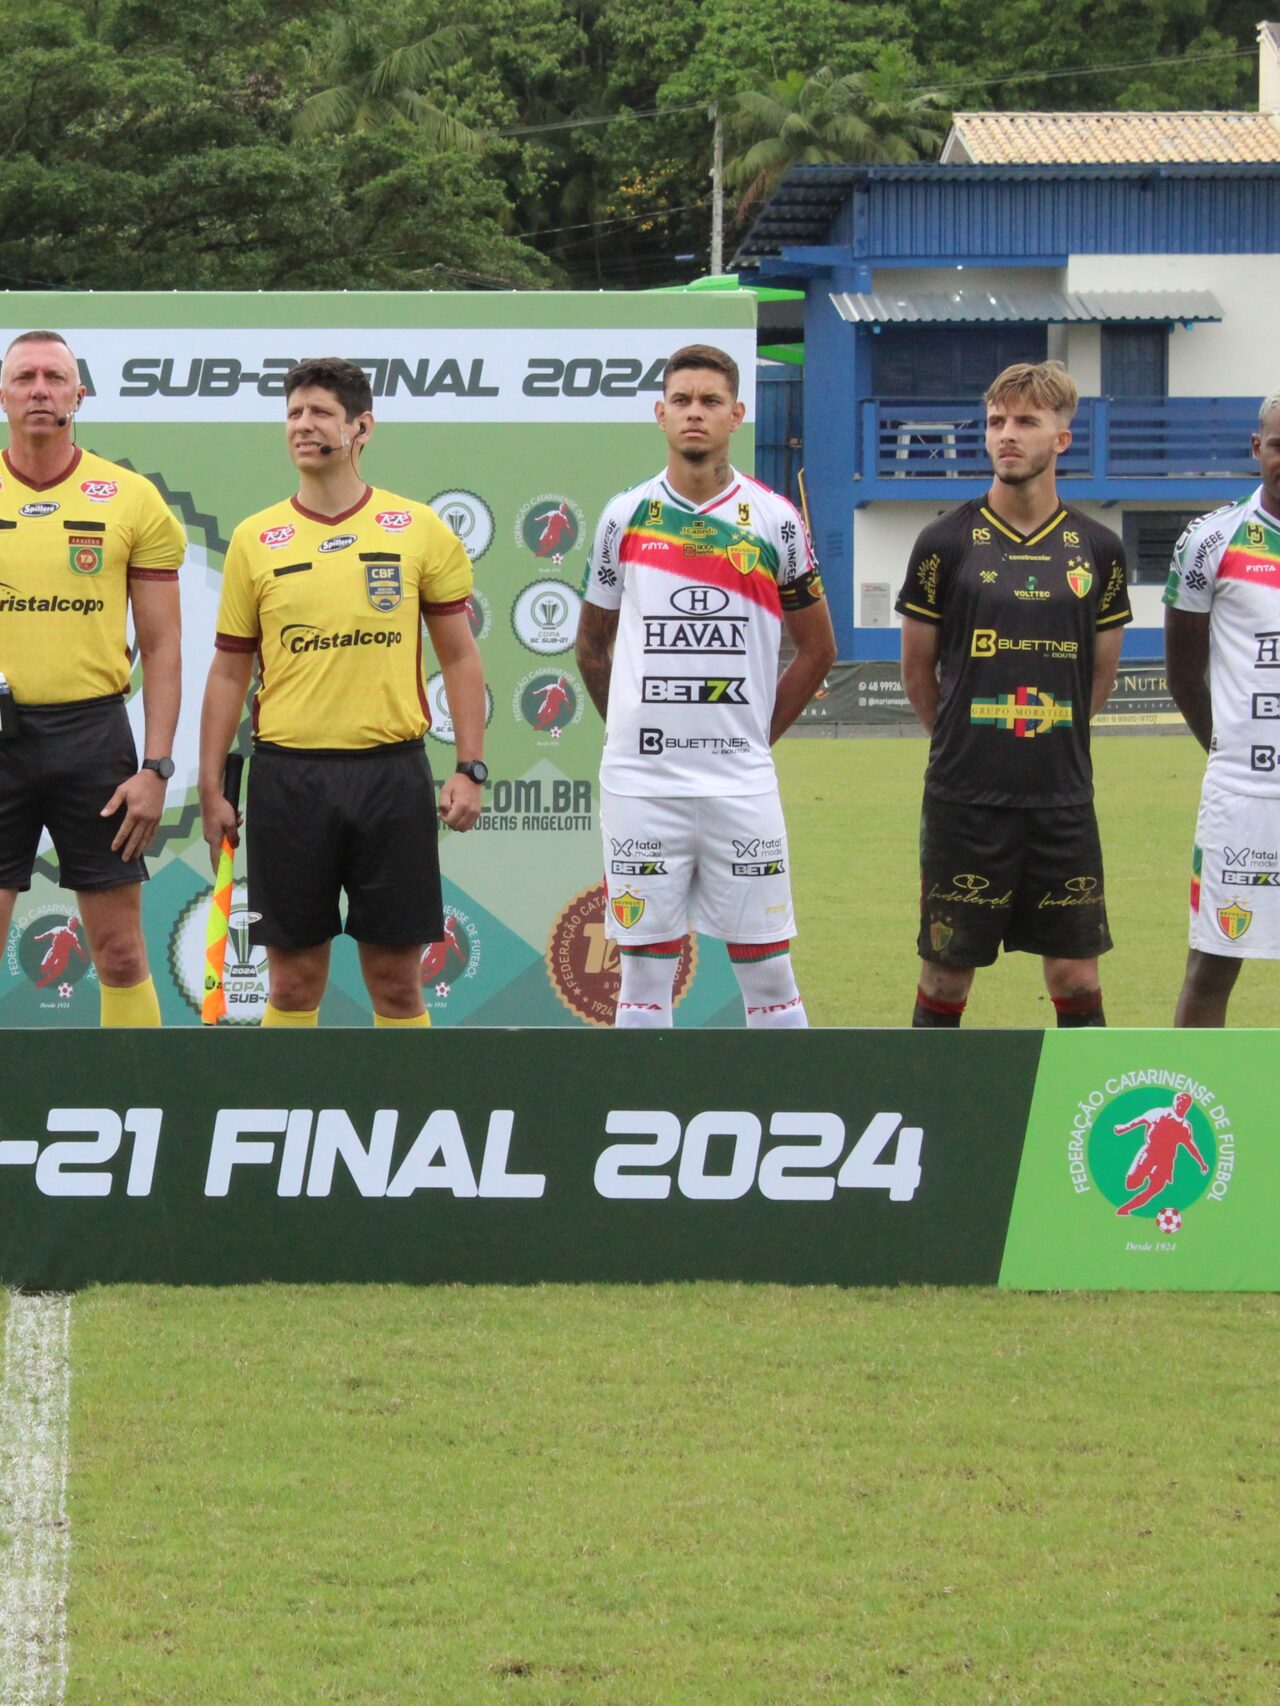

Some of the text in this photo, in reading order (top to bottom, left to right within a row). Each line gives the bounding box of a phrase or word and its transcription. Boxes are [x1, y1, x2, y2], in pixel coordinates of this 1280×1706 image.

[120, 358, 312, 397] SUB-2
[1194, 530, 1225, 569] UNIFEBE
[371, 568, 395, 579] CBF
[689, 590, 710, 611] H
[1014, 590, 1051, 598] VOLTTEC
[289, 629, 402, 654] Cristalcopo
[644, 623, 747, 648] HAVAN
[998, 638, 1078, 653] BUETTNER
[971, 705, 1010, 717] GRUPO
[665, 737, 751, 749] BUETTNER
[476, 815, 592, 831] UBENS ANGELOTTI
[635, 839, 662, 850] fatal
[464, 938, 481, 980] FUTEBOL
[560, 915, 581, 989] FEDERAÇÃO
[230, 967, 256, 975] 2024
[224, 981, 265, 992] COPA
[591, 1000, 614, 1017] 1924
[1068, 1069, 1235, 1202] FEDERAÇÃO CATARINENSE DE FUTEBOL
[204, 1108, 547, 1198] FINAL
[594, 1110, 924, 1202] 2024
[1125, 1242, 1153, 1251] Desde
